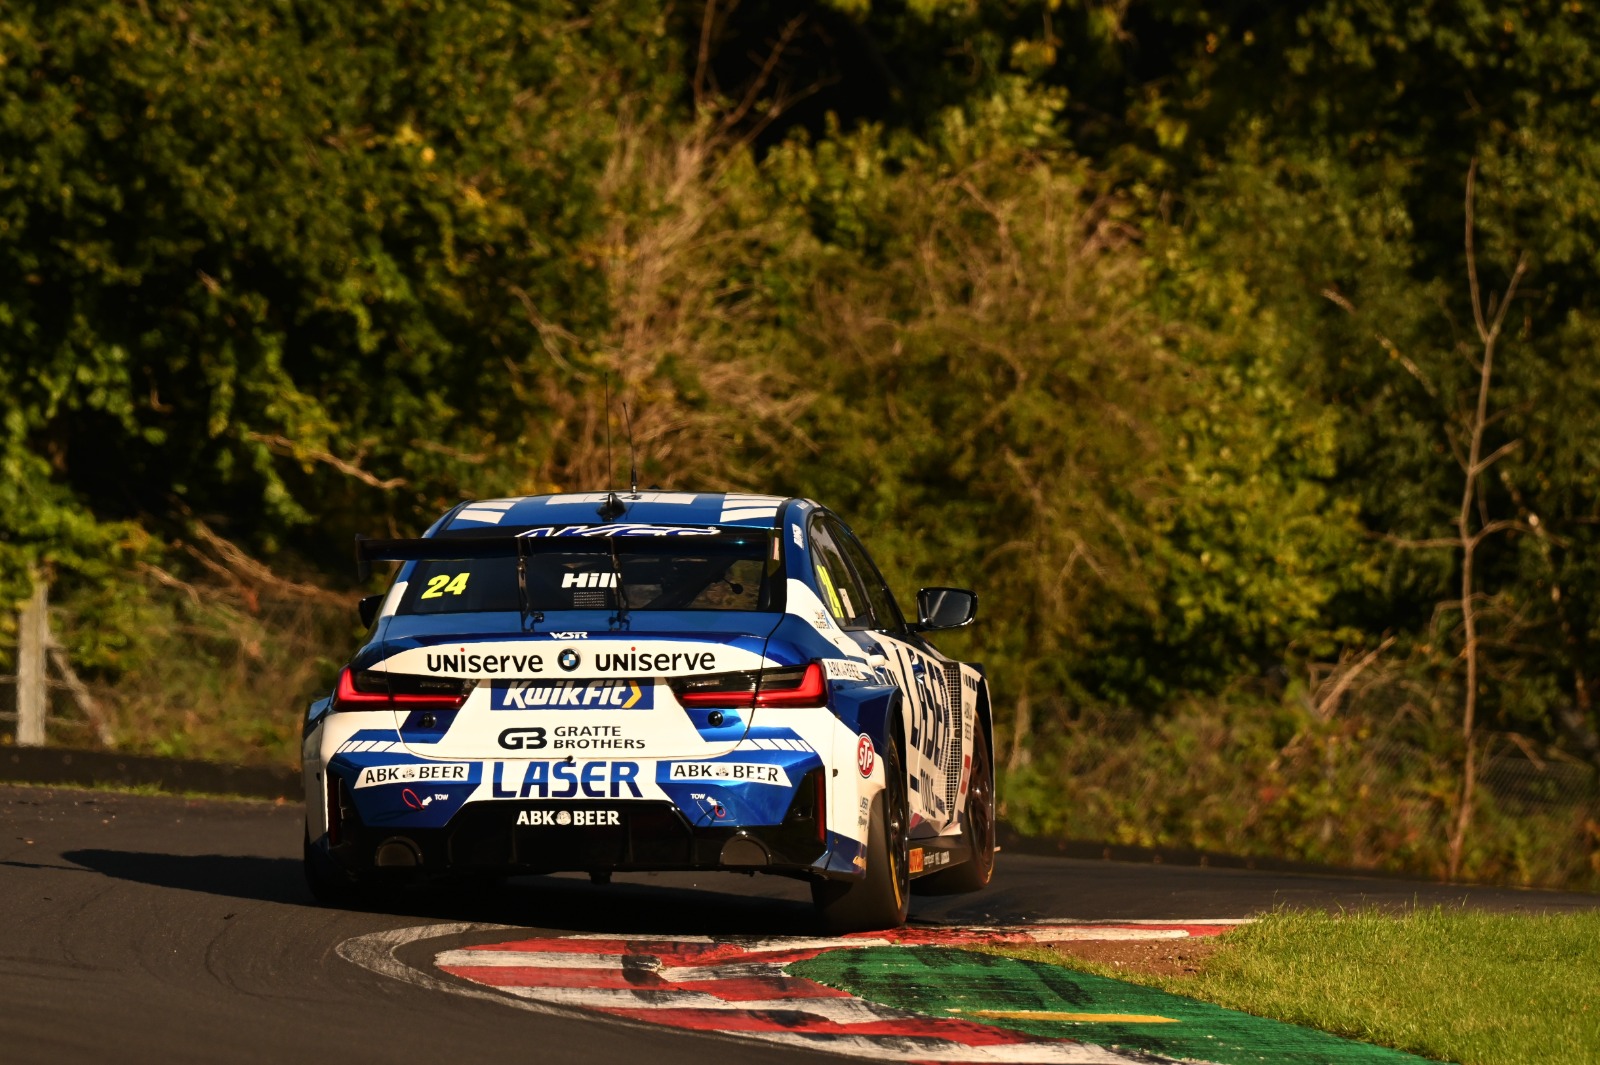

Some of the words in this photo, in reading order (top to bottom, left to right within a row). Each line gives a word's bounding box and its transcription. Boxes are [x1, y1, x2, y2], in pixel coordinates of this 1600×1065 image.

[421, 572, 470, 599] 24
[561, 572, 622, 588] Hill
[554, 726, 621, 737] GRATTE
[554, 739, 646, 749] BROTHERS
[859, 740, 873, 770] STP
[365, 768, 400, 784] ABK
[419, 766, 464, 779] BEER
[492, 761, 643, 798] LASER
[674, 765, 712, 777] ABK
[733, 765, 778, 782] BEER
[516, 810, 556, 825] ABK
[573, 810, 620, 825] BEER
